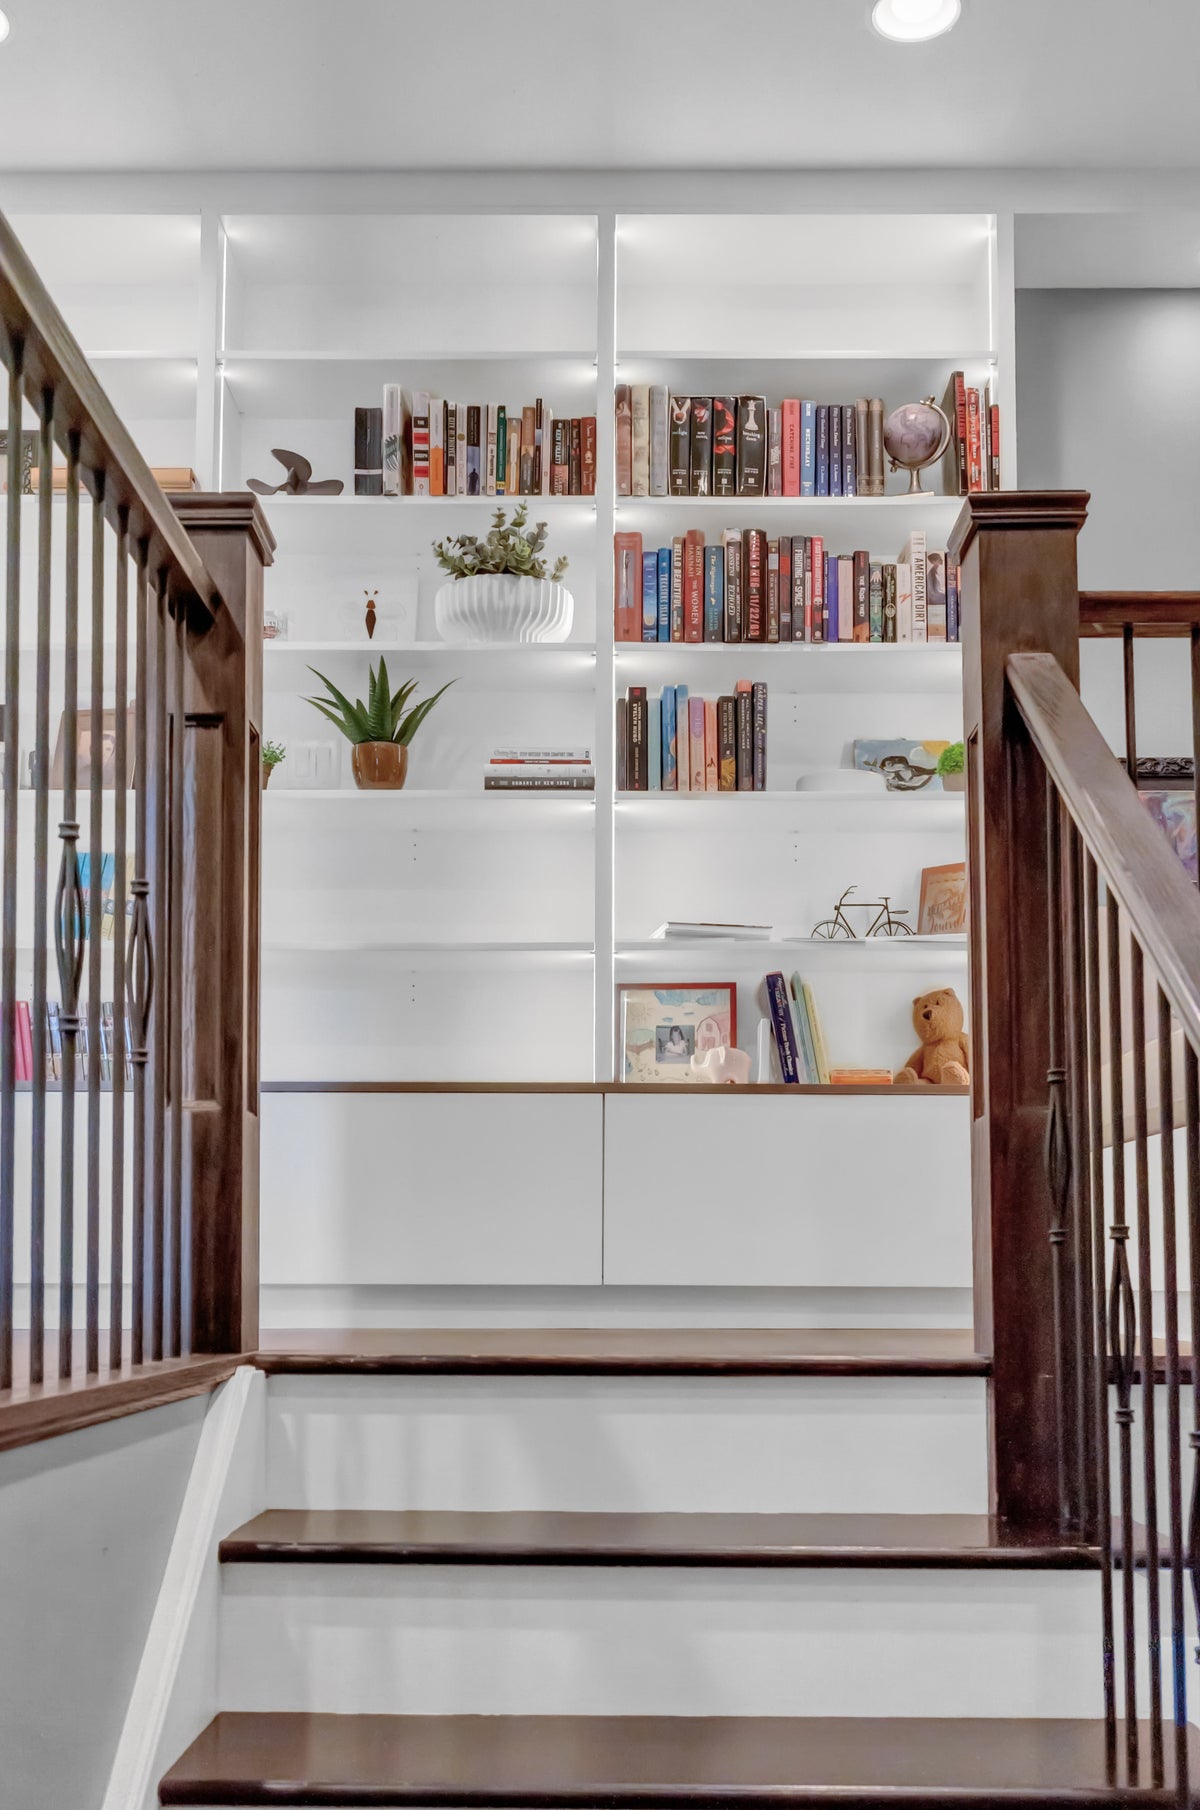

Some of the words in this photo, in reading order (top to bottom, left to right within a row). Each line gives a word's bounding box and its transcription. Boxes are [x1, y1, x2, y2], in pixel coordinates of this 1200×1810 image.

[958, 405, 966, 438] KILLERS
[660, 573, 668, 602] TREASURE
[750, 569, 760, 588] KING
[915, 558, 924, 601] AMERICAN
[660, 604, 668, 625] ISLAND
[915, 605, 924, 623] DIRT
